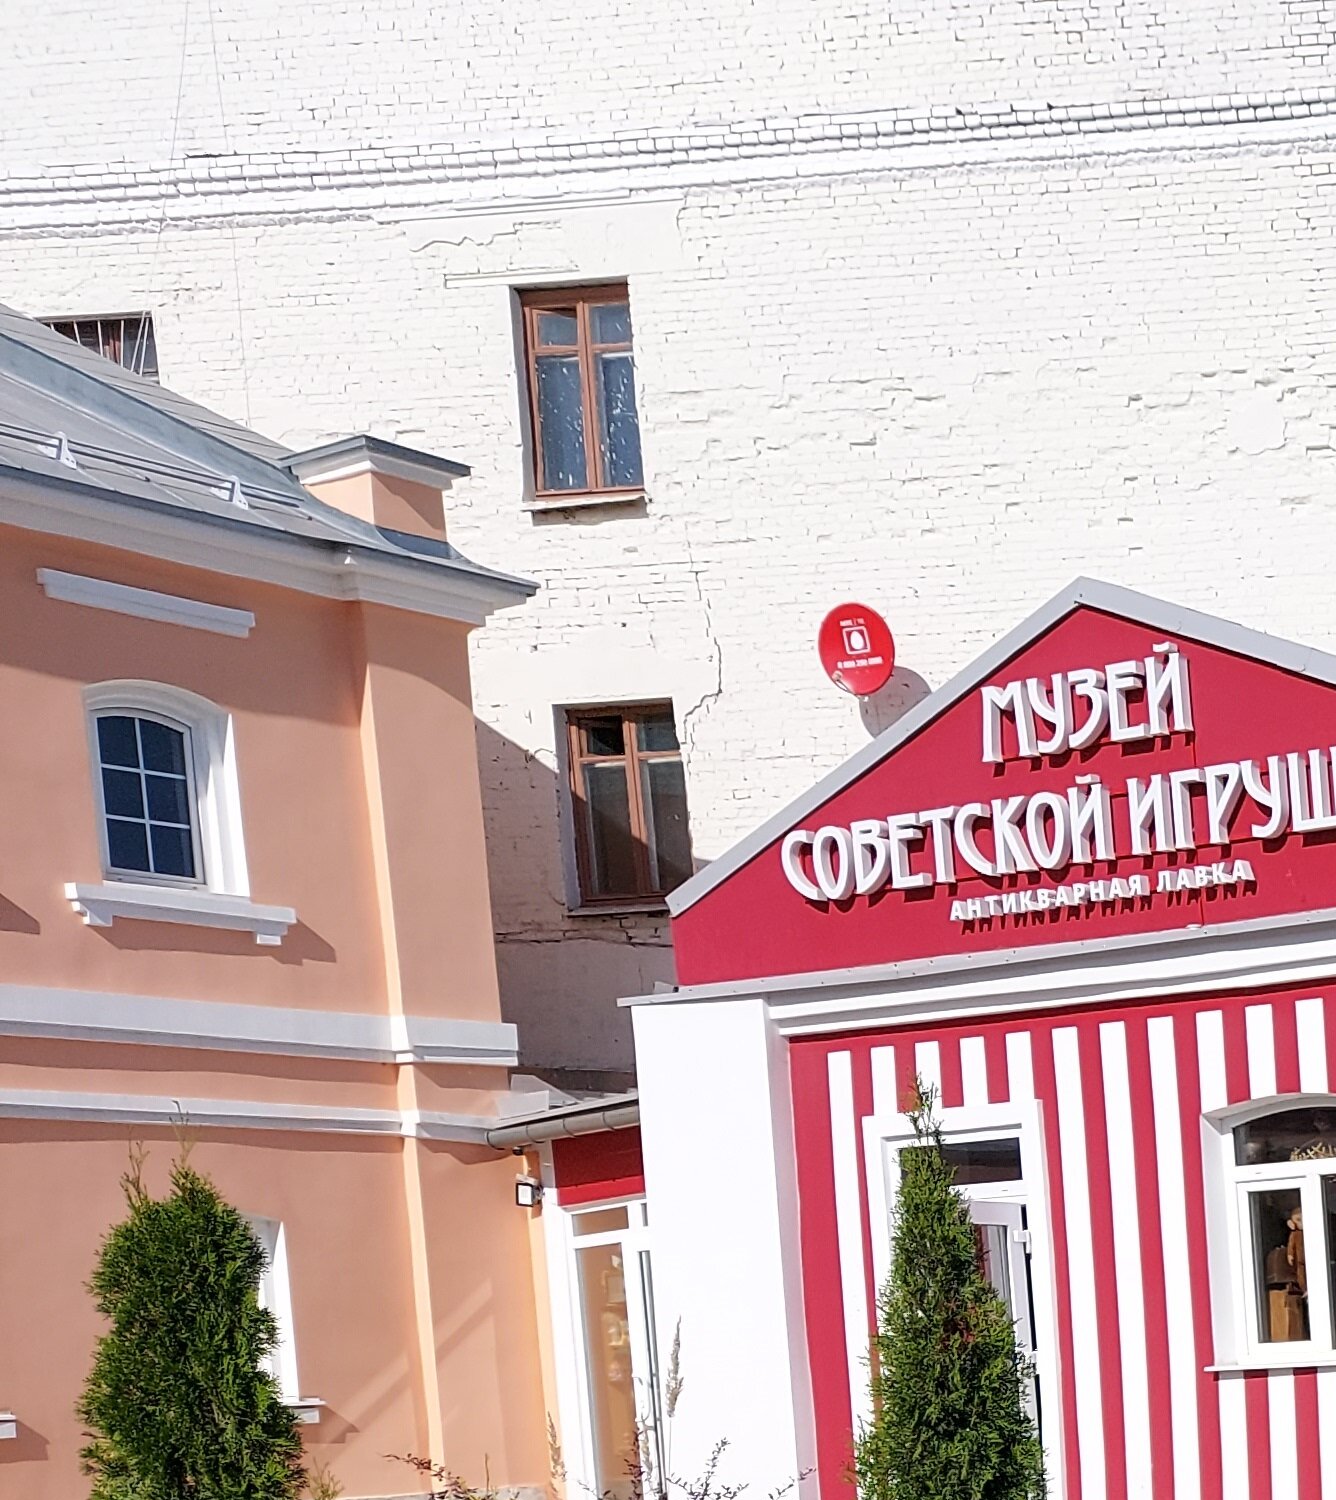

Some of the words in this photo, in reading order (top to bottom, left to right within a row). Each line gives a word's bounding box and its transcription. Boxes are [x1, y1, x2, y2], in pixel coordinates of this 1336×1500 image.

[981, 642, 1194, 762] МУЗЕЙ
[781, 774, 1115, 901] СОВЕТСКОЙ
[950, 873, 1150, 921] АНТИКВАРНАЯ
[1157, 860, 1255, 897] ЛАВКА
